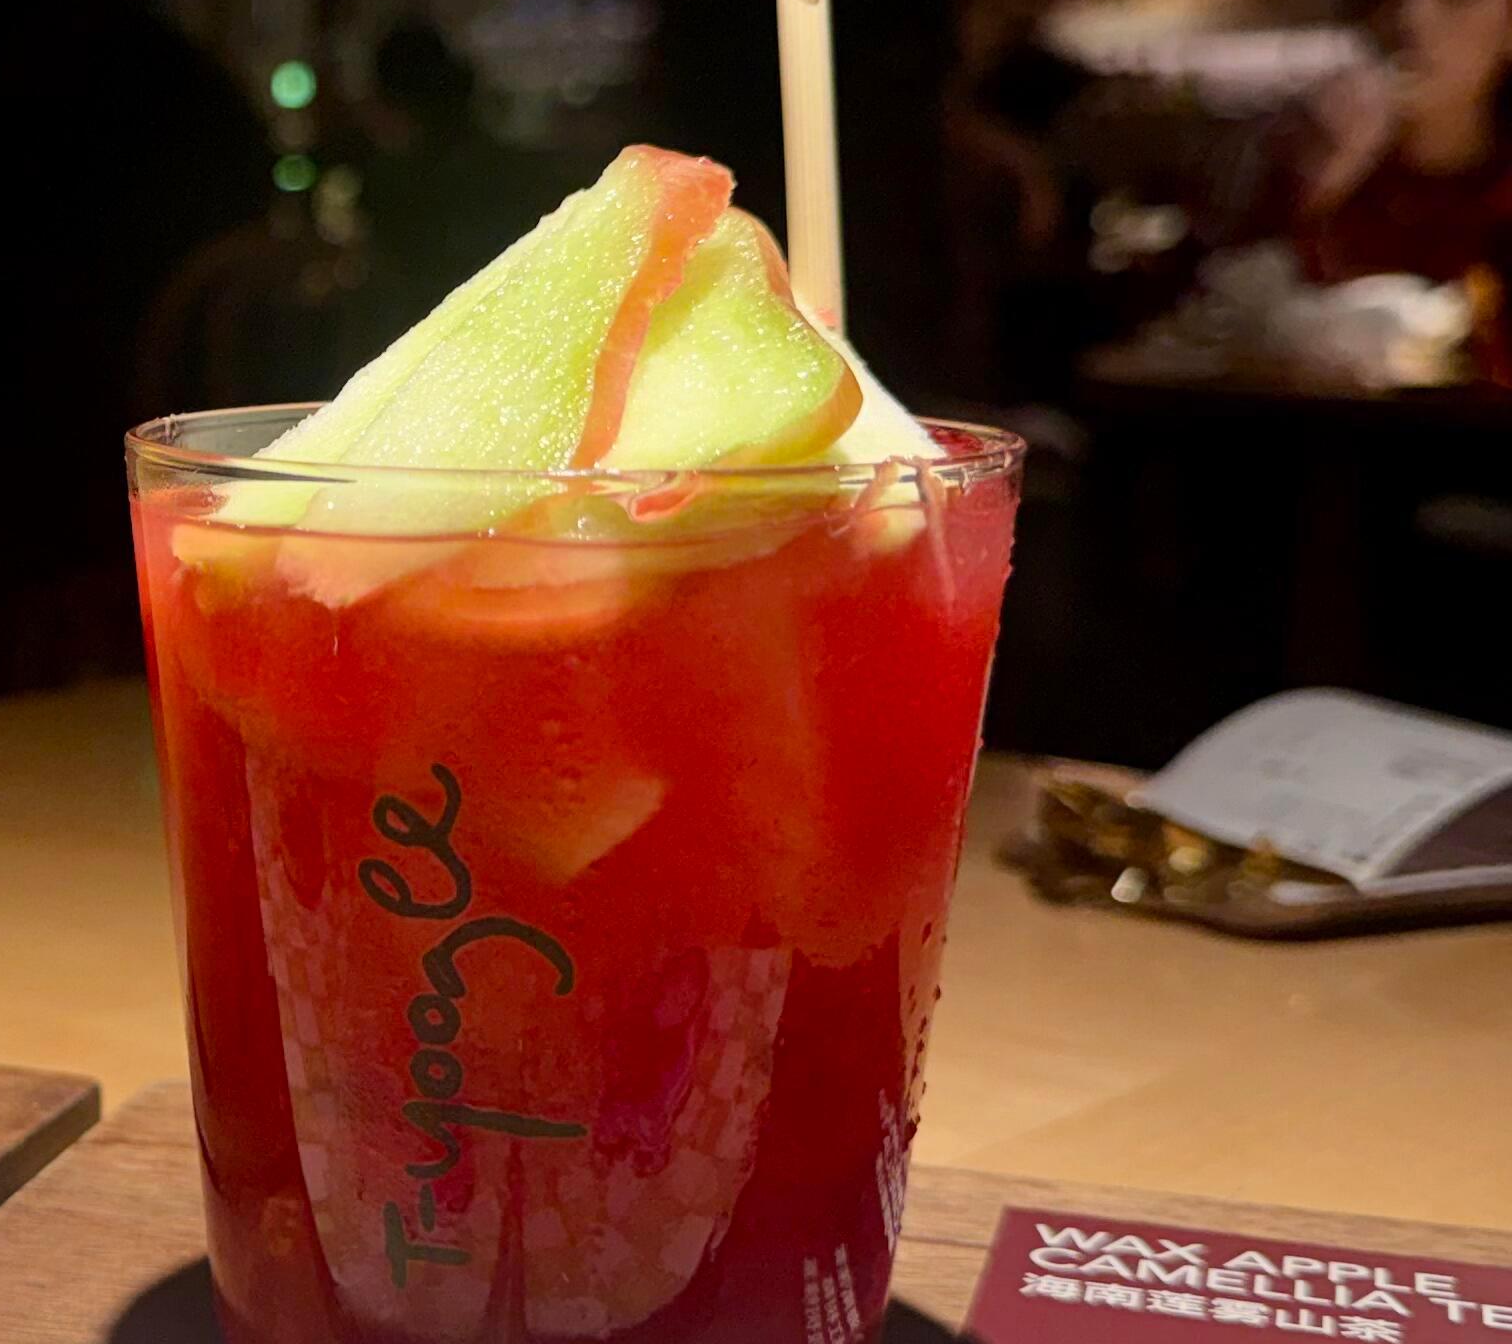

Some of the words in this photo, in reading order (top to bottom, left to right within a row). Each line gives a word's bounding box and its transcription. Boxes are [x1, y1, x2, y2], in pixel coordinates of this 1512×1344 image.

[1029, 1246, 1415, 1318] CAMELLIA
[1428, 1296, 1512, 1332] TE
[1035, 1223, 1209, 1267] WAX
[1222, 1250, 1461, 1299] APPLE
